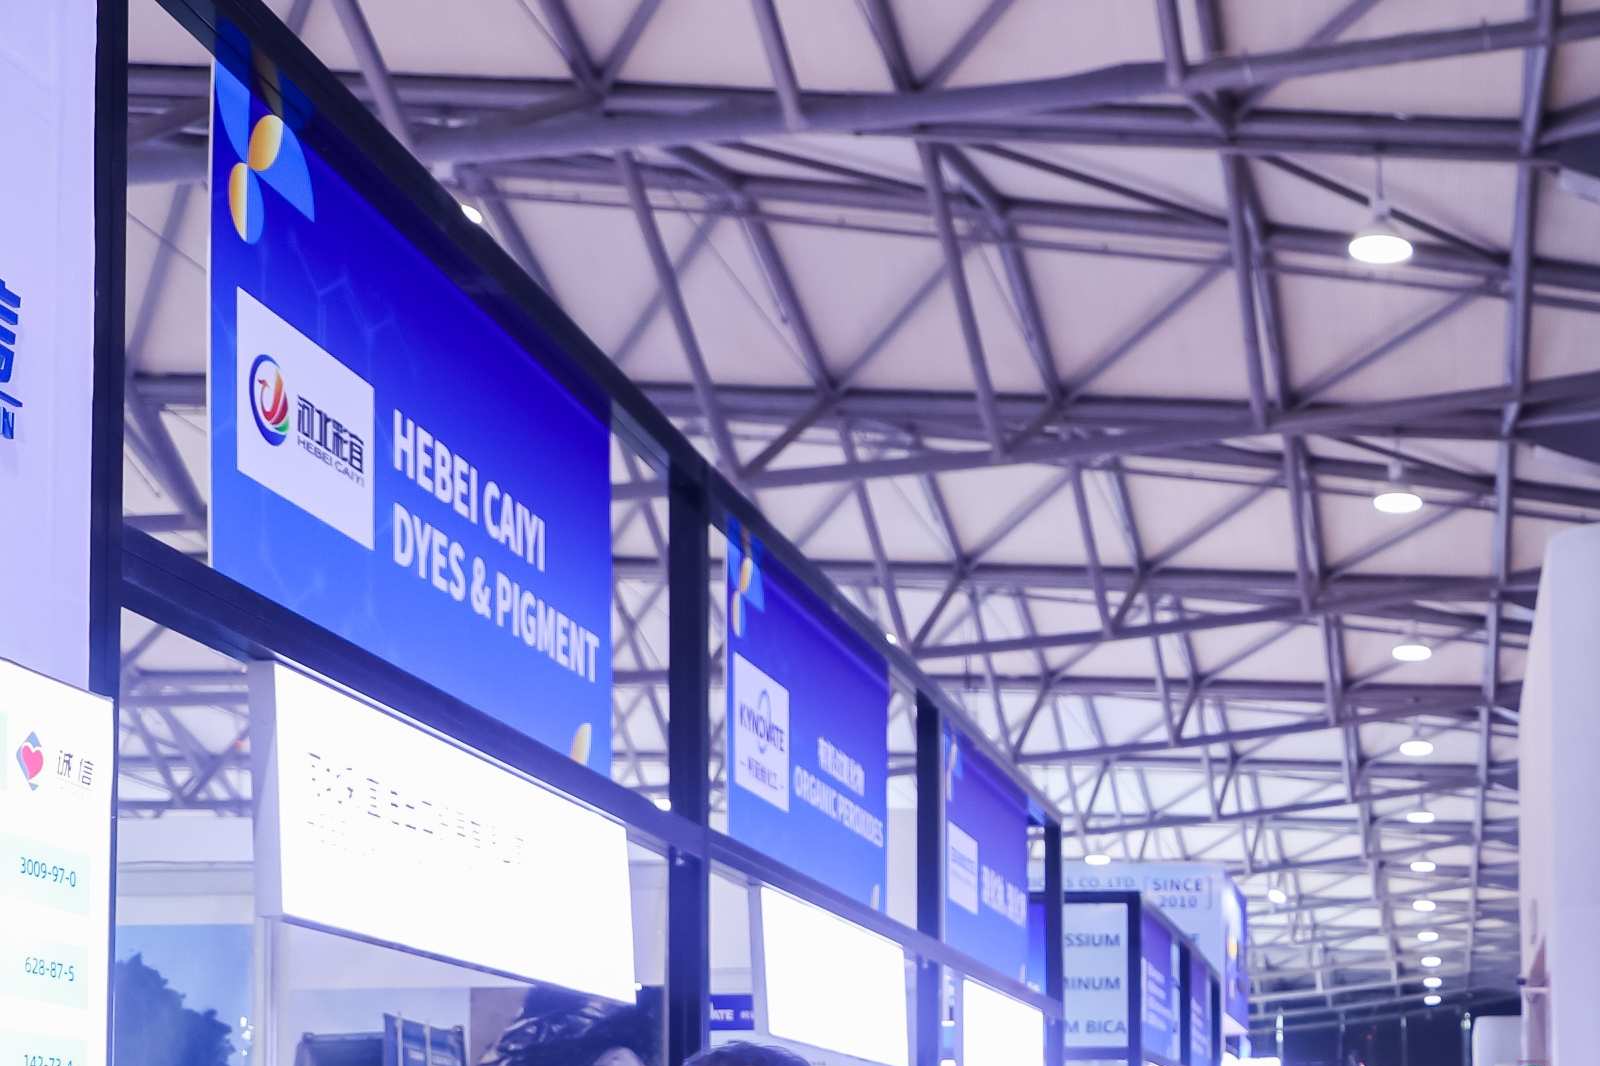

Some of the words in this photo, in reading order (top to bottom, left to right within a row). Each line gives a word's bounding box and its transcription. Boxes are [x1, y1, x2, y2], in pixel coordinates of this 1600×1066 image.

[392, 408, 478, 521] HEBEI
[484, 481, 546, 572] CAIYI
[393, 502, 467, 600] DYES
[470, 557, 492, 616] &
[496, 573, 600, 684] PIGMENT
[57, 749, 94, 786] 诚信
[20, 857, 77, 888] 3009-97-0
[1152, 877, 1202, 892] SINCE
[24, 956, 75, 982] 628-87-5
